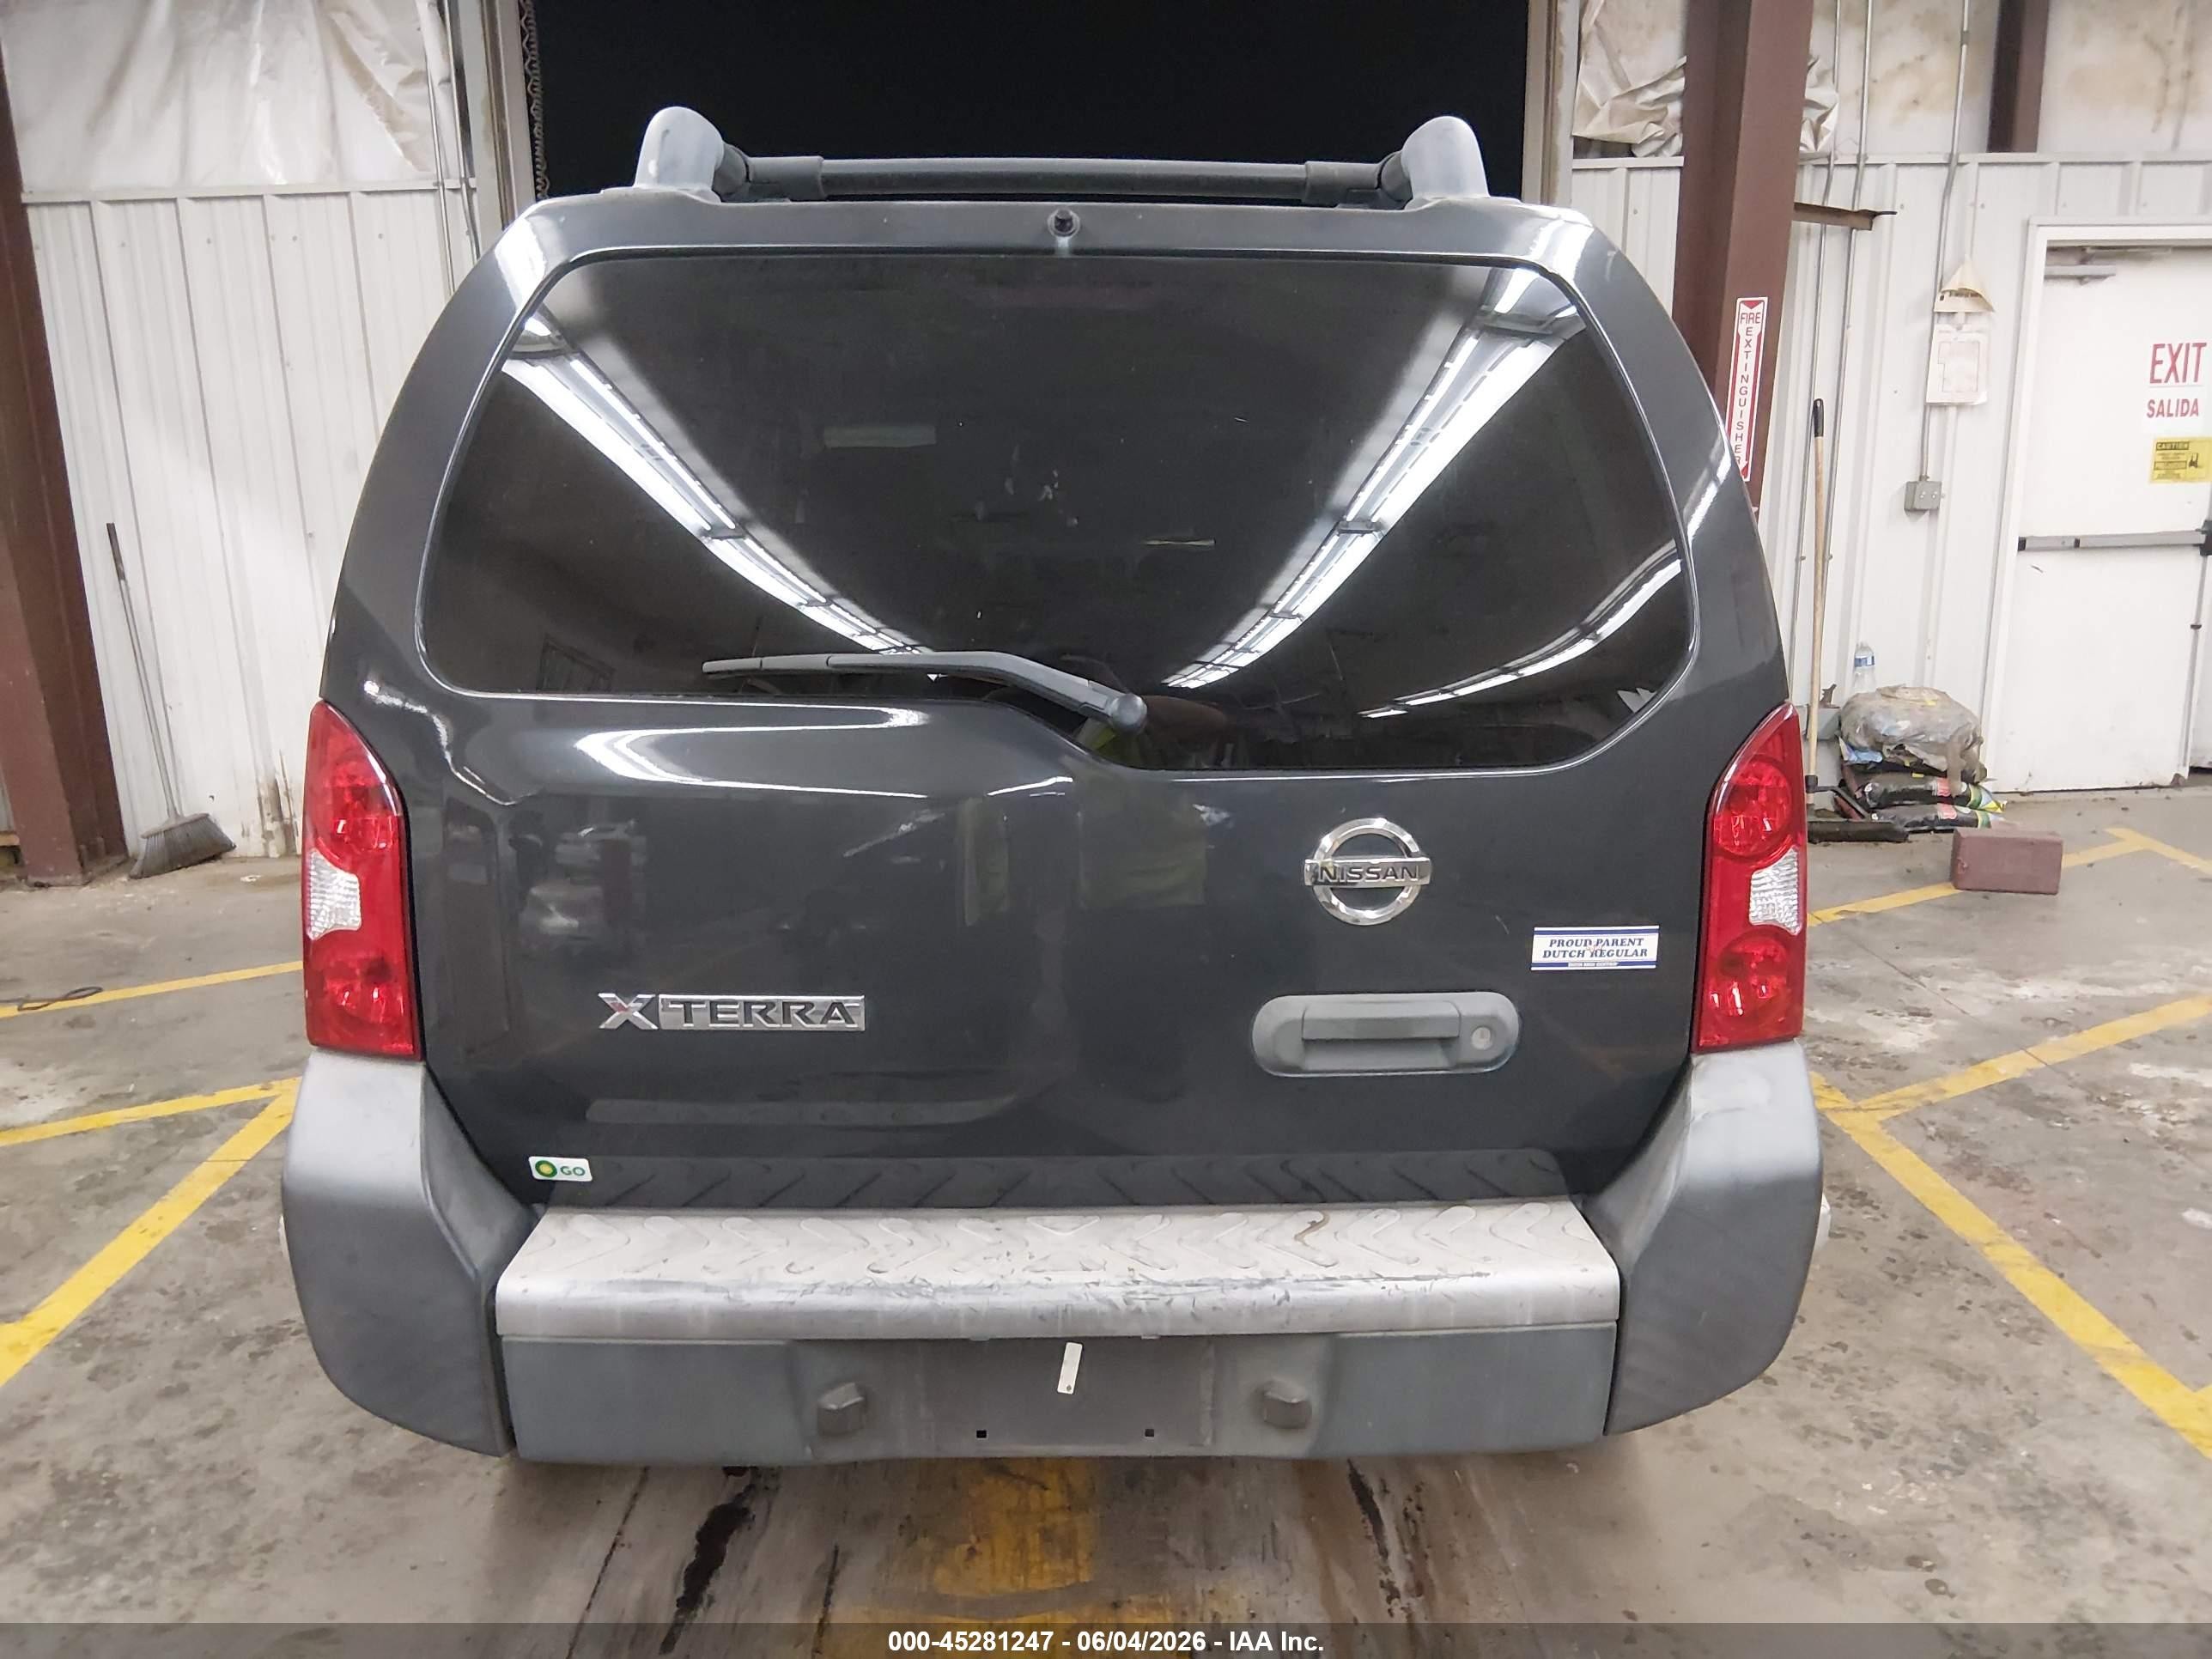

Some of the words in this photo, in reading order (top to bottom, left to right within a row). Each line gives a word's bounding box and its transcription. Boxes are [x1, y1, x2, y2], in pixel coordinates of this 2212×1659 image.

[1740, 313, 1761, 325] FIRE
[2149, 342, 2207, 384] EXIT
[1735, 326, 1753, 465] EXTINGUISHER
[2147, 398, 2200, 418] SALIDA
[1318, 864, 1419, 883] NISSAN
[1549, 939, 1591, 948] PROUD
[1595, 938, 1644, 947] PARENT
[1542, 950, 1586, 958] DUTCH
[1589, 949, 1648, 958] REGULAR
[560, 1165, 586, 1176] GO
